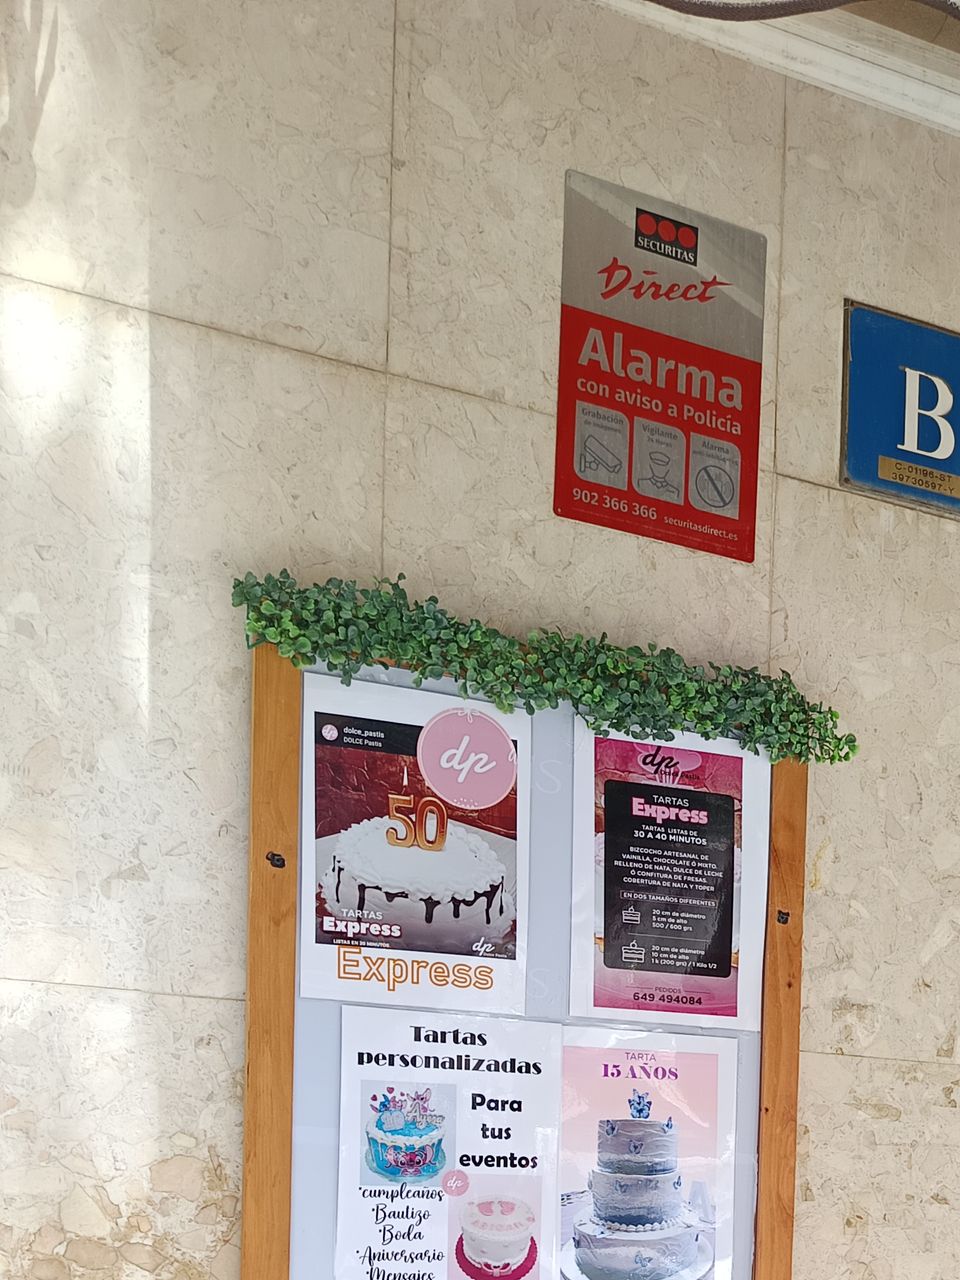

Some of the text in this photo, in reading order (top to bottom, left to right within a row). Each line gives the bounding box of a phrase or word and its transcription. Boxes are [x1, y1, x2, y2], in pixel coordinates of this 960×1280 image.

[637, 236, 695, 262] SECURITAS
[597, 257, 733, 303] Direct
[577, 327, 742, 412] Alarma
[577, 378, 742, 435] con aviso a Policía
[897, 367, 955, 460] B
[582, 407, 624, 425] Grabación
[641, 423, 679, 441] Vigilante
[702, 440, 730, 455] Alarma
[572, 488, 599, 506] 902
[602, 495, 628, 513] 366
[631, 502, 658, 520] 366
[664, 515, 738, 541] securitasdirect.es
[343, 726, 385, 738] dolce_pastis
[343, 736, 382, 747] DOLCE Pastis
[440, 735, 496, 784] dp
[642, 746, 679, 774] dp
[652, 794, 690, 807] TARTAS
[632, 797, 708, 824] Express
[386, 793, 448, 851] 50
[642, 824, 665, 833] TARTAS
[667, 827, 688, 836] LISTAS
[633, 830, 708, 846] 30 A 40 MINUTOS
[629, 846, 662, 855] BIZCOCHO
[663, 850, 699, 860] ARTESANAL
[653, 857, 690, 867] CHOCOLATE
[613, 860, 643, 869] RELLENO
[673, 866, 693, 874] DULCE
[637, 870, 672, 880] CONFITURA
[623, 876, 661, 886] COBERTURA
[695, 884, 715, 892] TOPER
[648, 894, 678, 903] TAMAÑOS
[679, 897, 715, 907] DIFERENTES
[342, 908, 383, 920] TARTAS
[322, 916, 401, 937] Express
[472, 936, 495, 957] dp
[337, 945, 494, 991] Express
[633, 992, 703, 1005] 649 494084
[654, 986, 682, 994] PEDIDOS
[409, 1025, 488, 1047] Tartas
[357, 1051, 542, 1075] personalizadas
[625, 1052, 656, 1062] TARTA
[601, 1062, 679, 1081] 15 AÑOS
[471, 1092, 523, 1112] Para
[480, 1123, 512, 1140] tus
[459, 1152, 538, 1168] eventos
